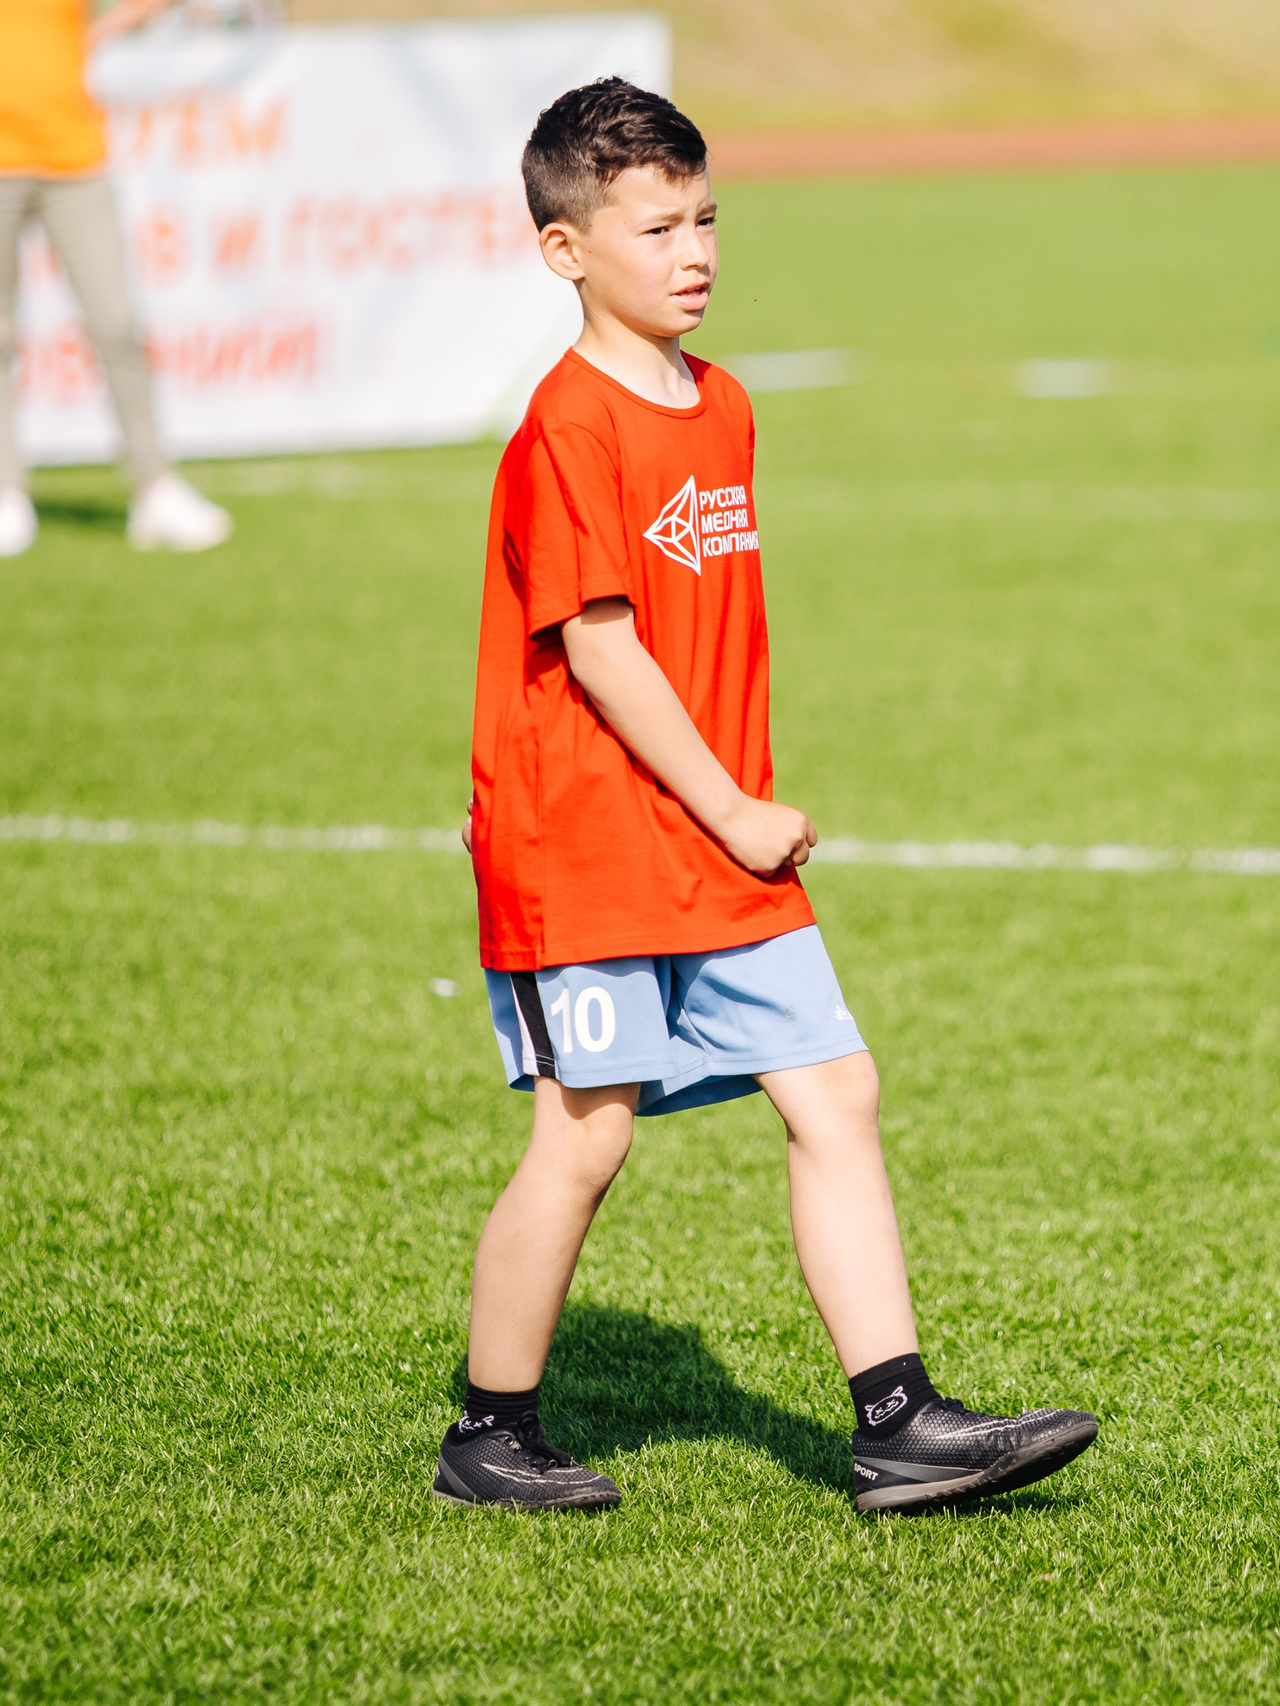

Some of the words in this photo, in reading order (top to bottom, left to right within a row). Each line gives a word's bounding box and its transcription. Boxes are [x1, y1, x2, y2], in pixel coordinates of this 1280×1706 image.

[287, 188, 537, 274] ГОСТЕ
[699, 485, 747, 511] РУССКАЯ
[701, 508, 749, 534] МЕДНАЯ
[551, 986, 616, 1054] 10
